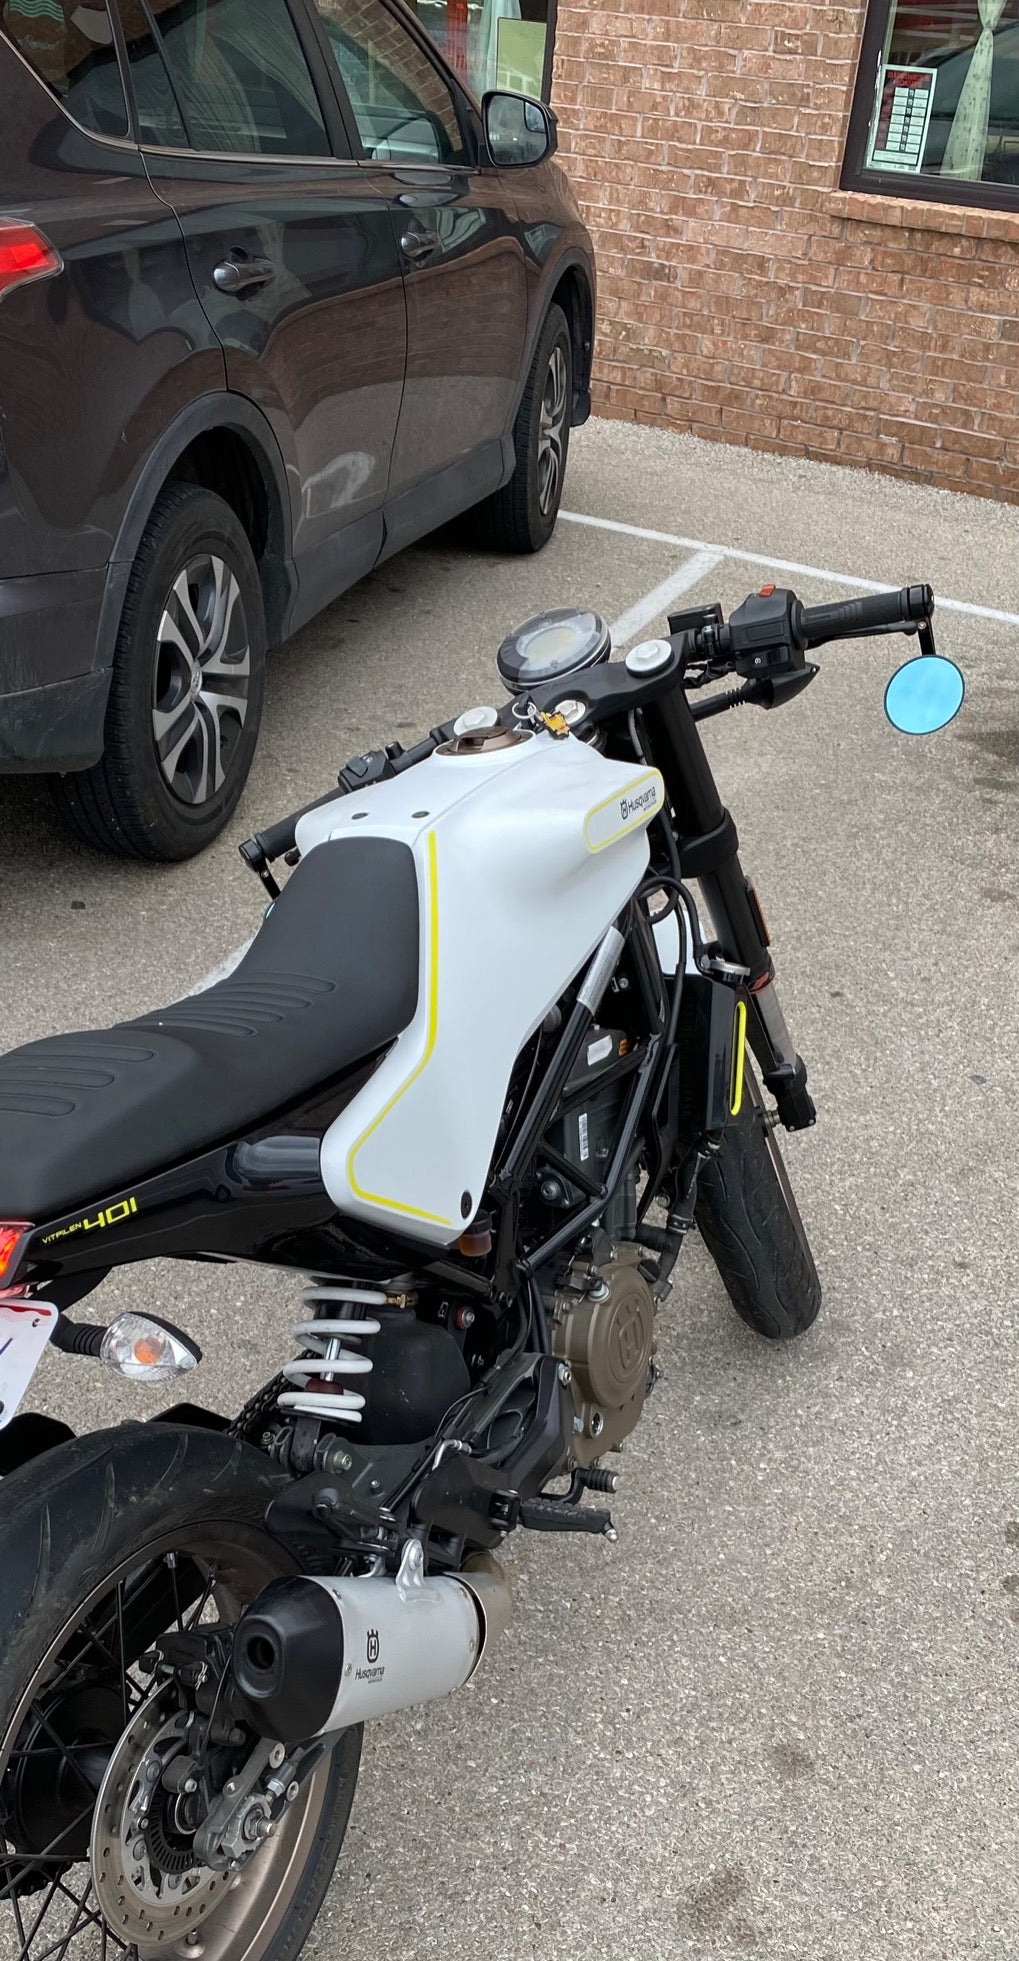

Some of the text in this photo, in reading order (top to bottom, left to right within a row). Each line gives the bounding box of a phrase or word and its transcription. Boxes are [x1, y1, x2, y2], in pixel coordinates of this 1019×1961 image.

[628, 786, 656, 814] Husqvarna
[42, 1196, 138, 1244] VITPILEN 401
[355, 1666, 385, 1680] Husqvarna
